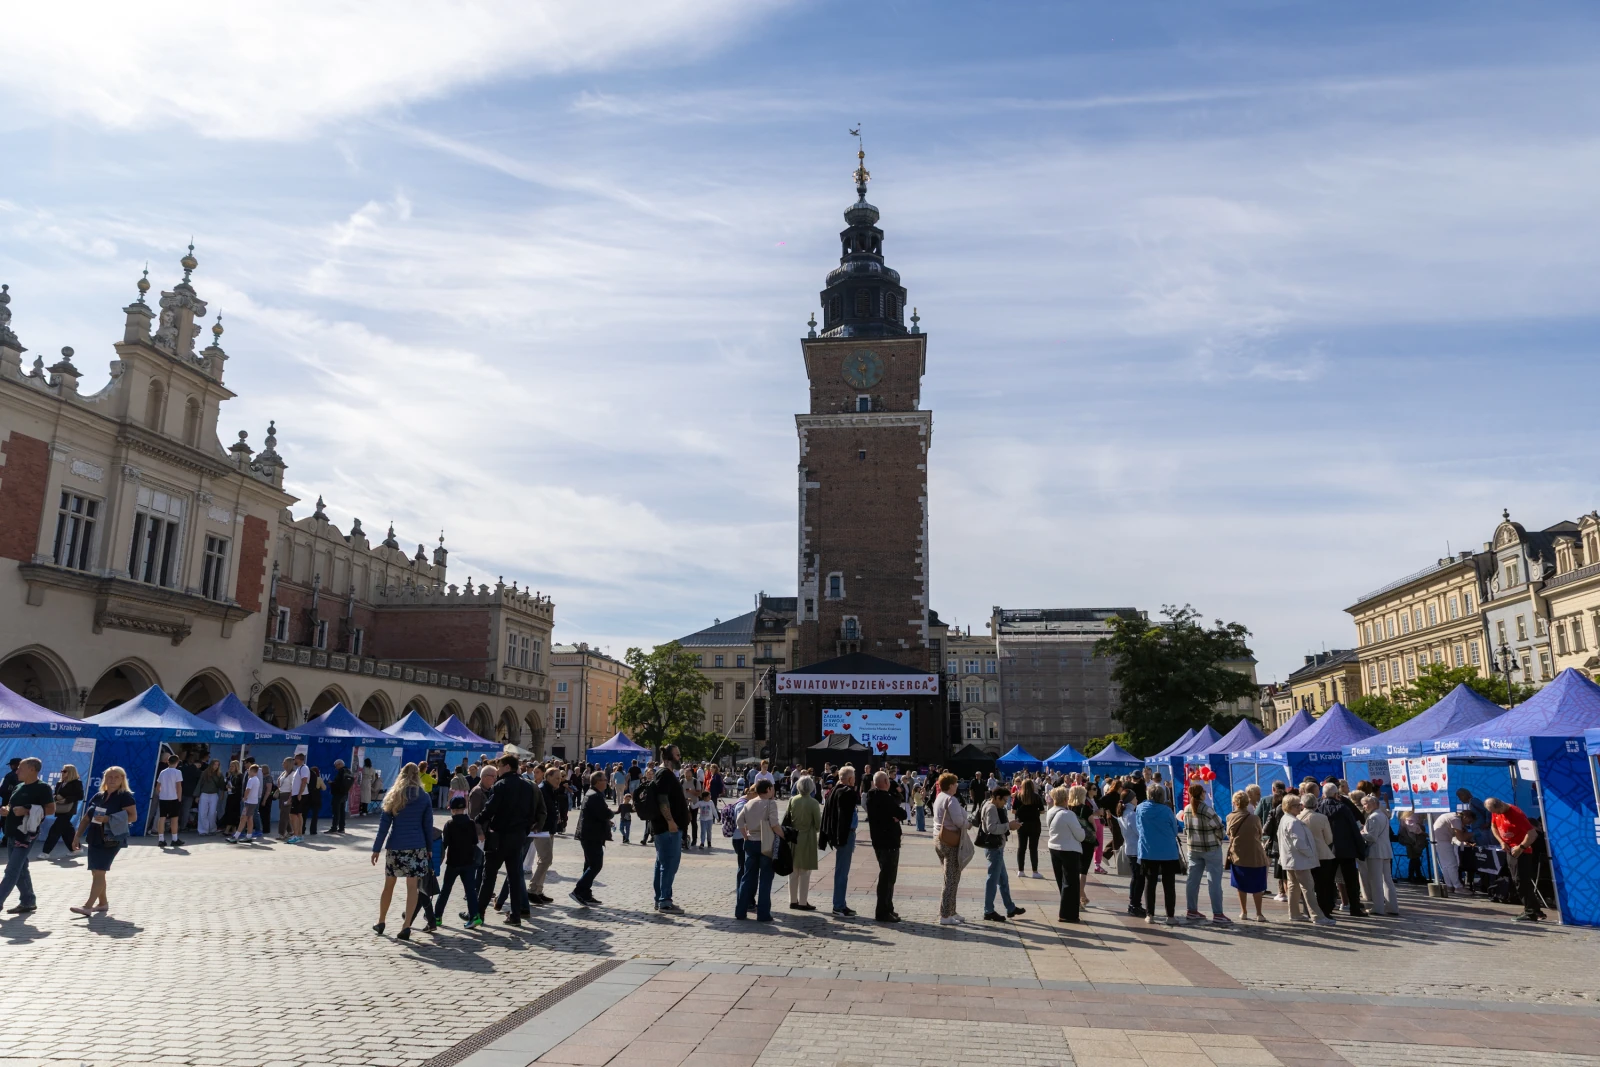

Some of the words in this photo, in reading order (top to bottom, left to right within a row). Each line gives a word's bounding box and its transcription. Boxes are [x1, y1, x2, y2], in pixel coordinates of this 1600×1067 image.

[785, 678, 845, 690] ŚWIATOWY
[852, 678, 885, 690] DZIEŃ
[892, 680, 928, 690] SERCA
[60, 724, 82, 732] Kraków
[1441, 740, 1459, 749] Kraków
[1490, 739, 1513, 749] Kraków
[1393, 746, 1409, 754] Kraków
